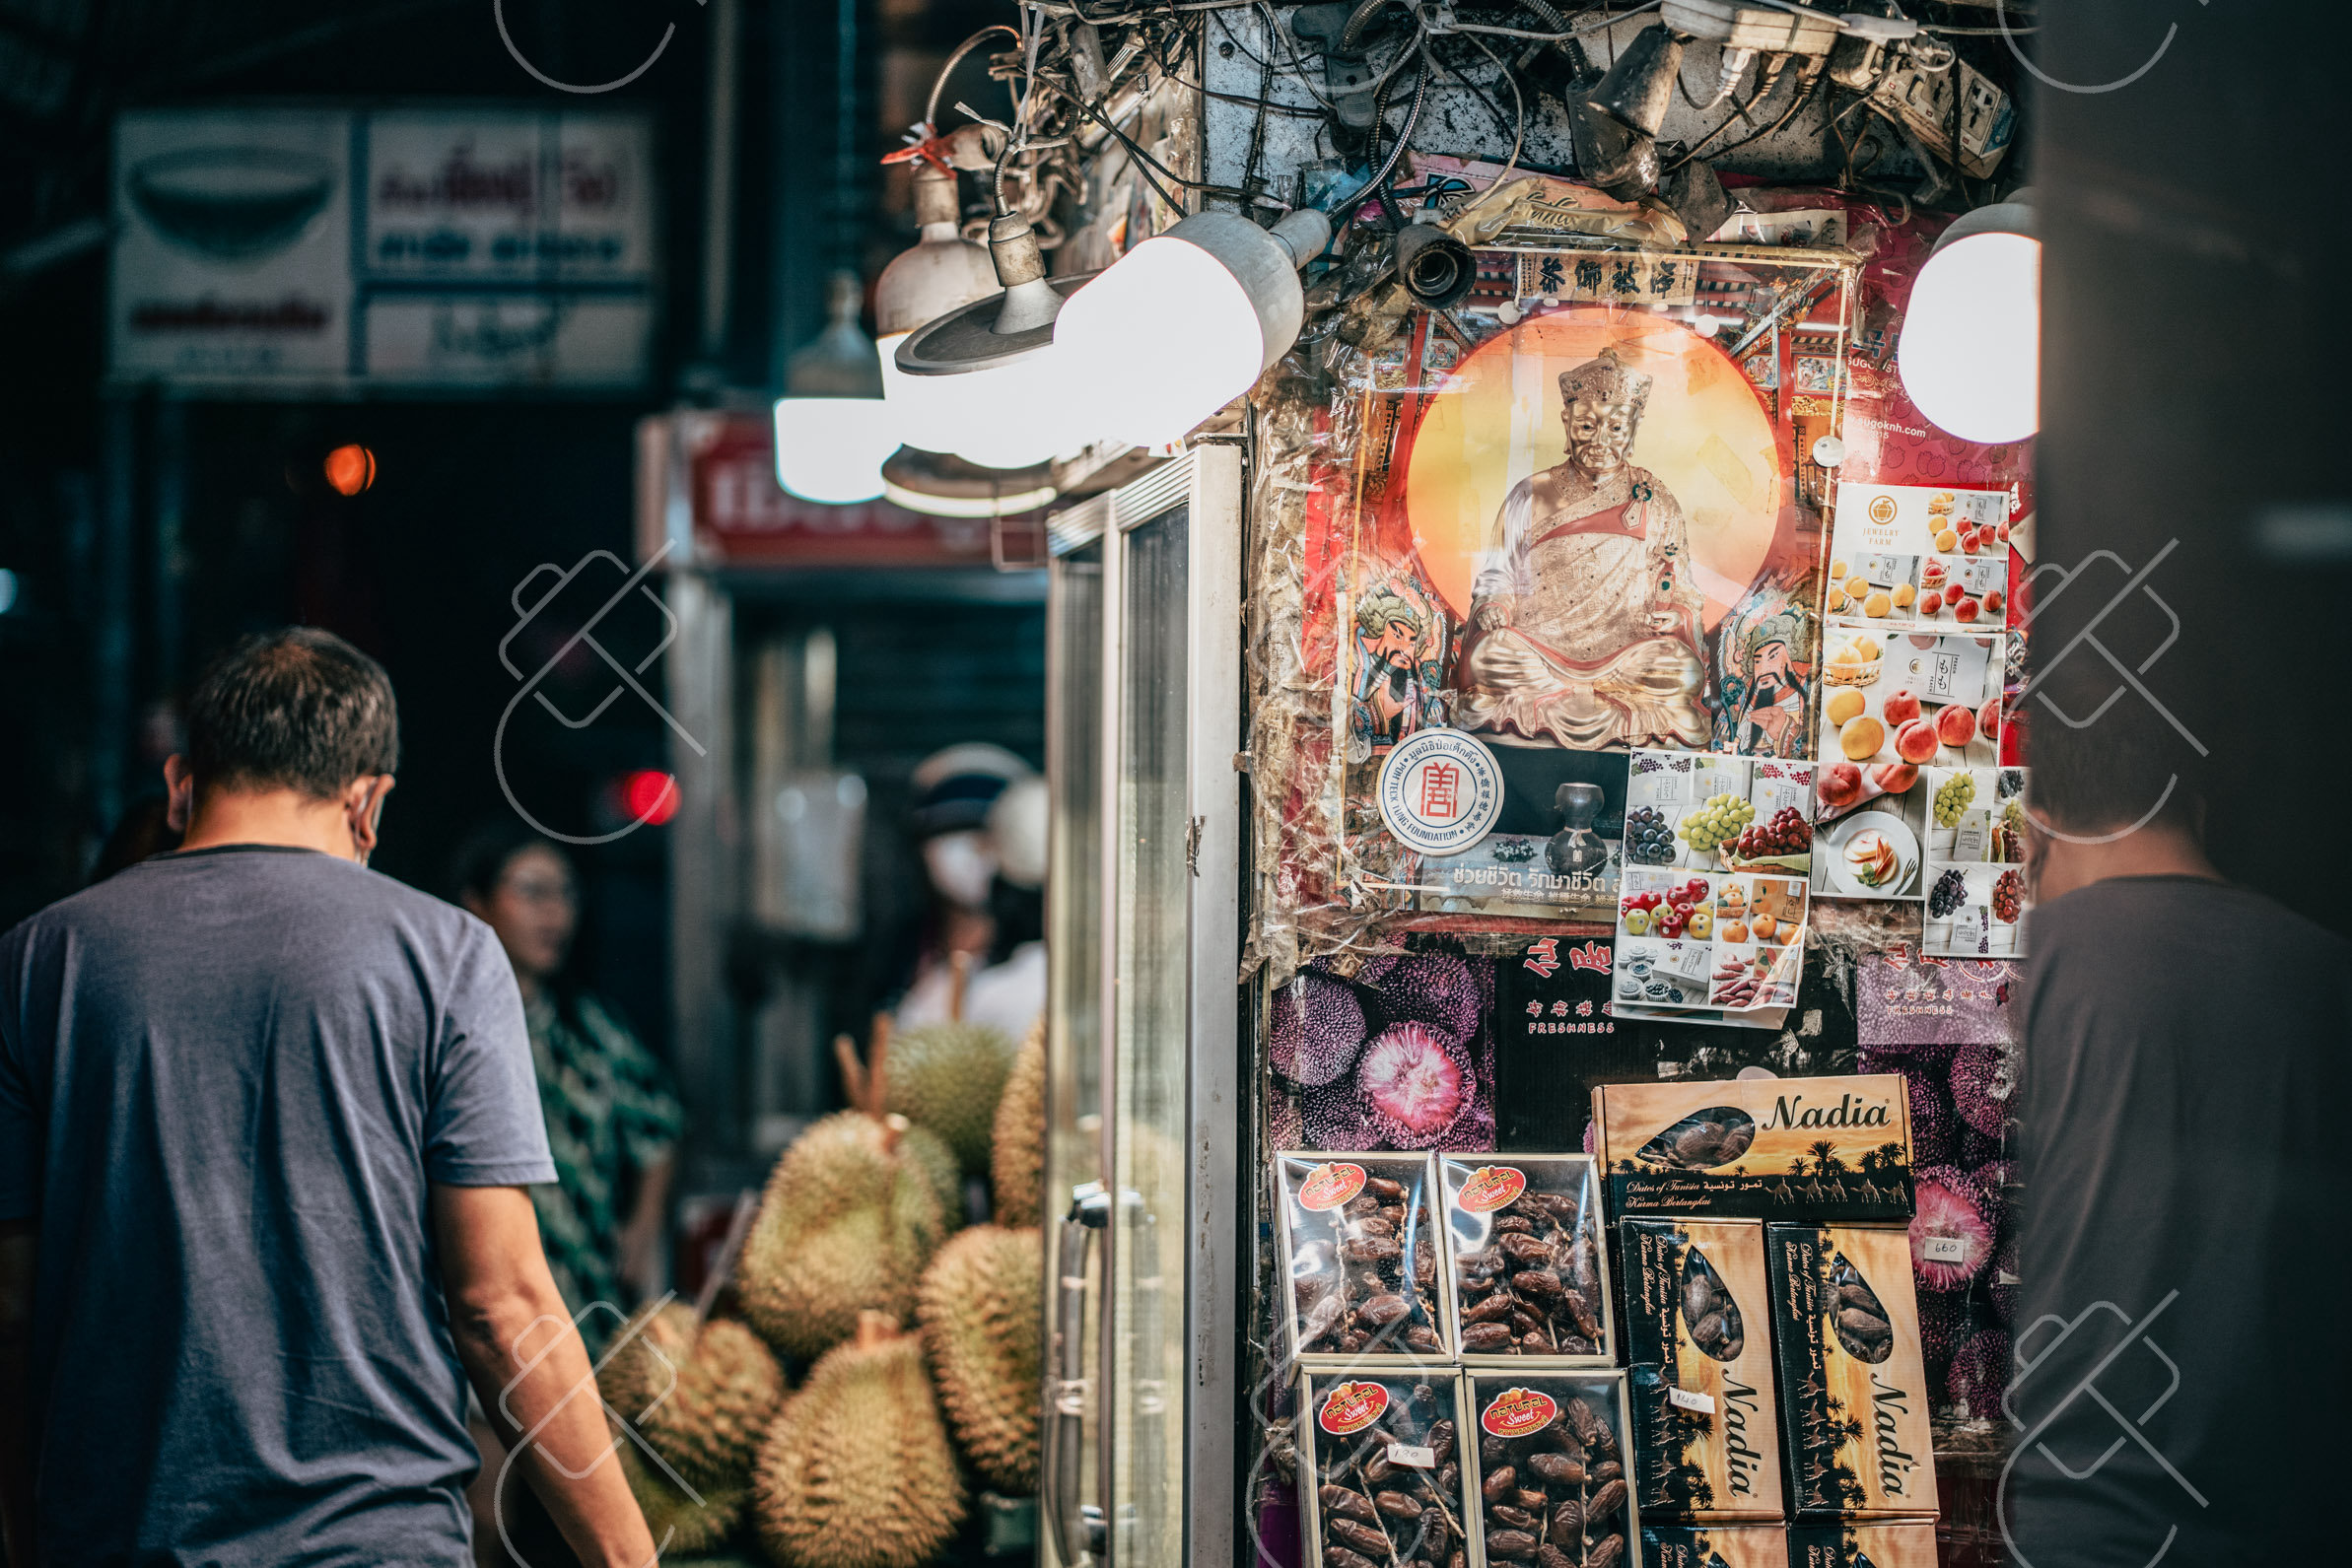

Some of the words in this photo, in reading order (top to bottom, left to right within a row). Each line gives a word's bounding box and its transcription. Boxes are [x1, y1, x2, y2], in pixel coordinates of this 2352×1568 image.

[1863, 527, 1900, 537] JEWELRY
[1394, 762, 1407, 781] POH
[1389, 782, 1399, 802] TECK
[1392, 803, 1409, 827] TUNG
[1407, 823, 1459, 842] FOUNDATION
[1453, 862, 1522, 887] ช่วยชีวิต
[1528, 868, 1606, 893] รักษาชีวิต
[1887, 1005, 1953, 1016] FRESHNESS
[1528, 1022, 1615, 1034] FRESHNESS
[1761, 1093, 1891, 1130] Nadia
[1323, 1179, 1348, 1198] Sweet
[1481, 1182, 1506, 1201] Sweet
[1626, 1181, 1655, 1193] Dates
[1656, 1183, 1667, 1195] of
[1666, 1179, 1699, 1191] Tunisia
[1703, 1180, 1735, 1192] تونسية
[1739, 1179, 1763, 1191] تمور
[1626, 1195, 1659, 1208] Kurma
[1661, 1194, 1712, 1210] Bertangkai
[1640, 1234, 1653, 1266] Kurma
[1656, 1235, 1668, 1262] Dates
[1785, 1241, 1798, 1273] Kurma
[1800, 1242, 1813, 1269] Dates
[1640, 1266, 1655, 1316] Bertangkai
[1658, 1271, 1672, 1305] Tunisia
[1787, 1273, 1802, 1321] Bertangkai
[1804, 1279, 1817, 1311] Tunisia
[1345, 1399, 1369, 1421] Sweet
[1506, 1408, 1535, 1425] Sweet
[1721, 1368, 1763, 1498] Nadia
[1870, 1372, 1914, 1498] Nadia
